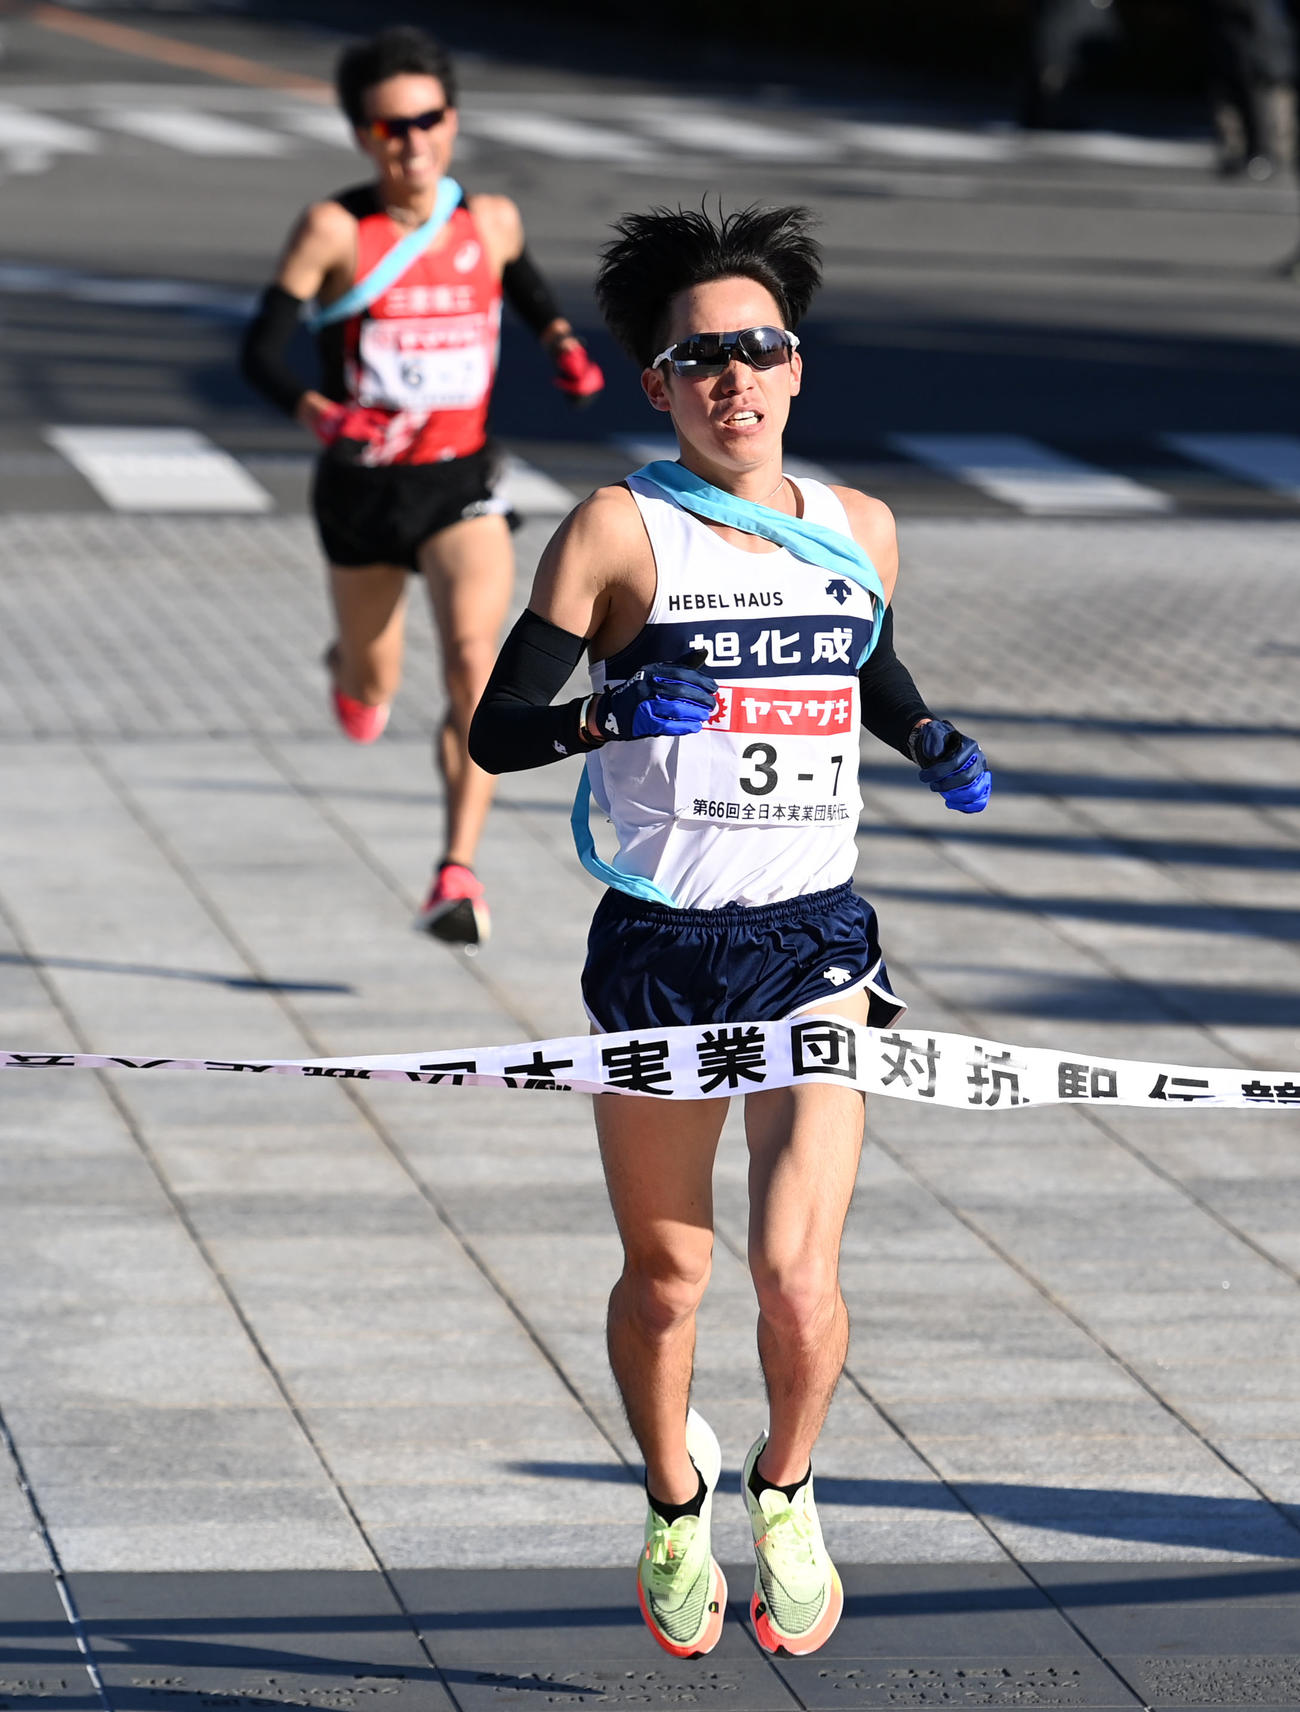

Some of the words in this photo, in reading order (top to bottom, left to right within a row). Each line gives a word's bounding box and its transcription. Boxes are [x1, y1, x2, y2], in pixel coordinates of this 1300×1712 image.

[668, 595, 729, 611] HEBEL
[734, 591, 784, 608] HAUS
[689, 627, 853, 668] 旭化成
[740, 696, 849, 727] ヤマザキ
